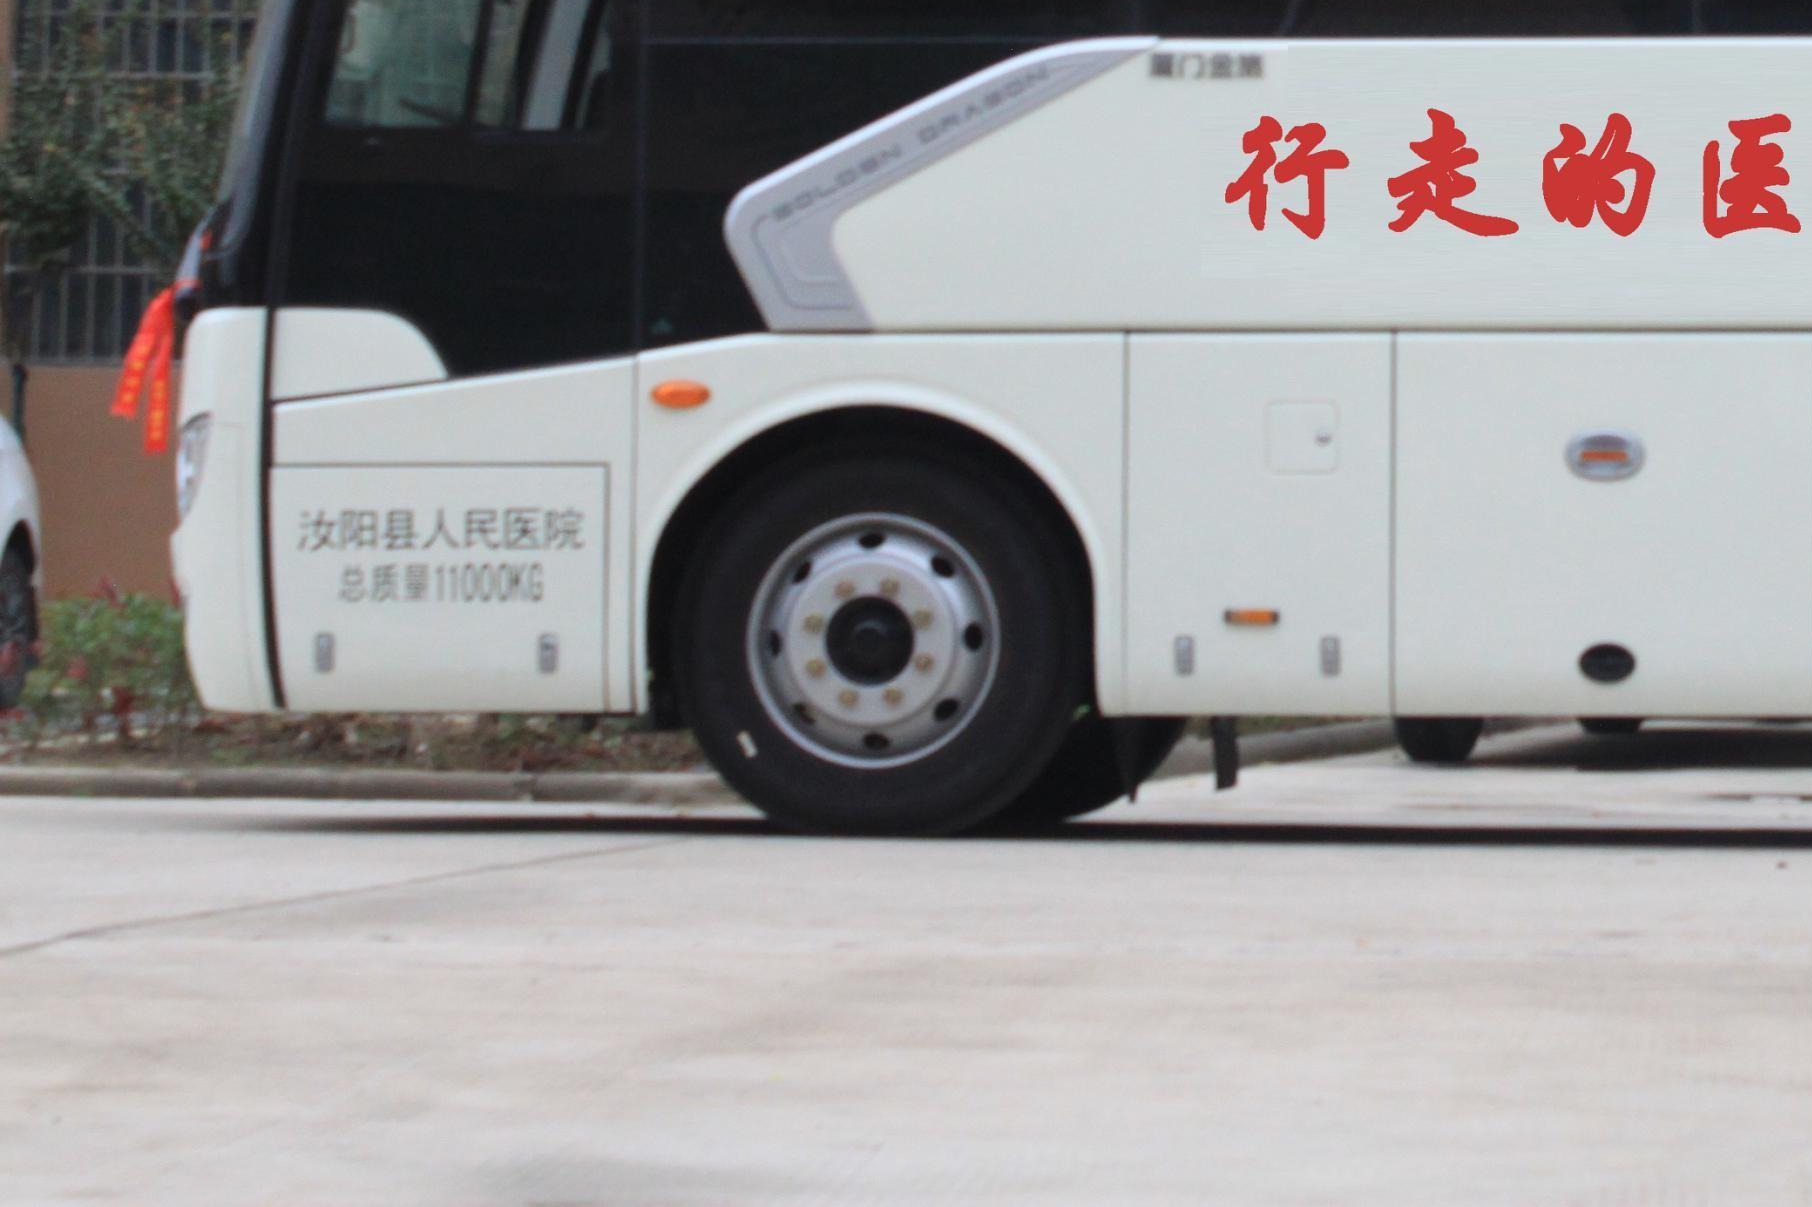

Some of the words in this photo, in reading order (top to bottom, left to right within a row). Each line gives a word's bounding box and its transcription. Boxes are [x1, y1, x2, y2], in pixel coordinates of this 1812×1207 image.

[773, 143, 903, 221] GOLDEN
[916, 63, 1050, 144] DRAGON
[297, 508, 586, 551] 汝阳县人民医院
[339, 563, 545, 603] 总质量11000KG
